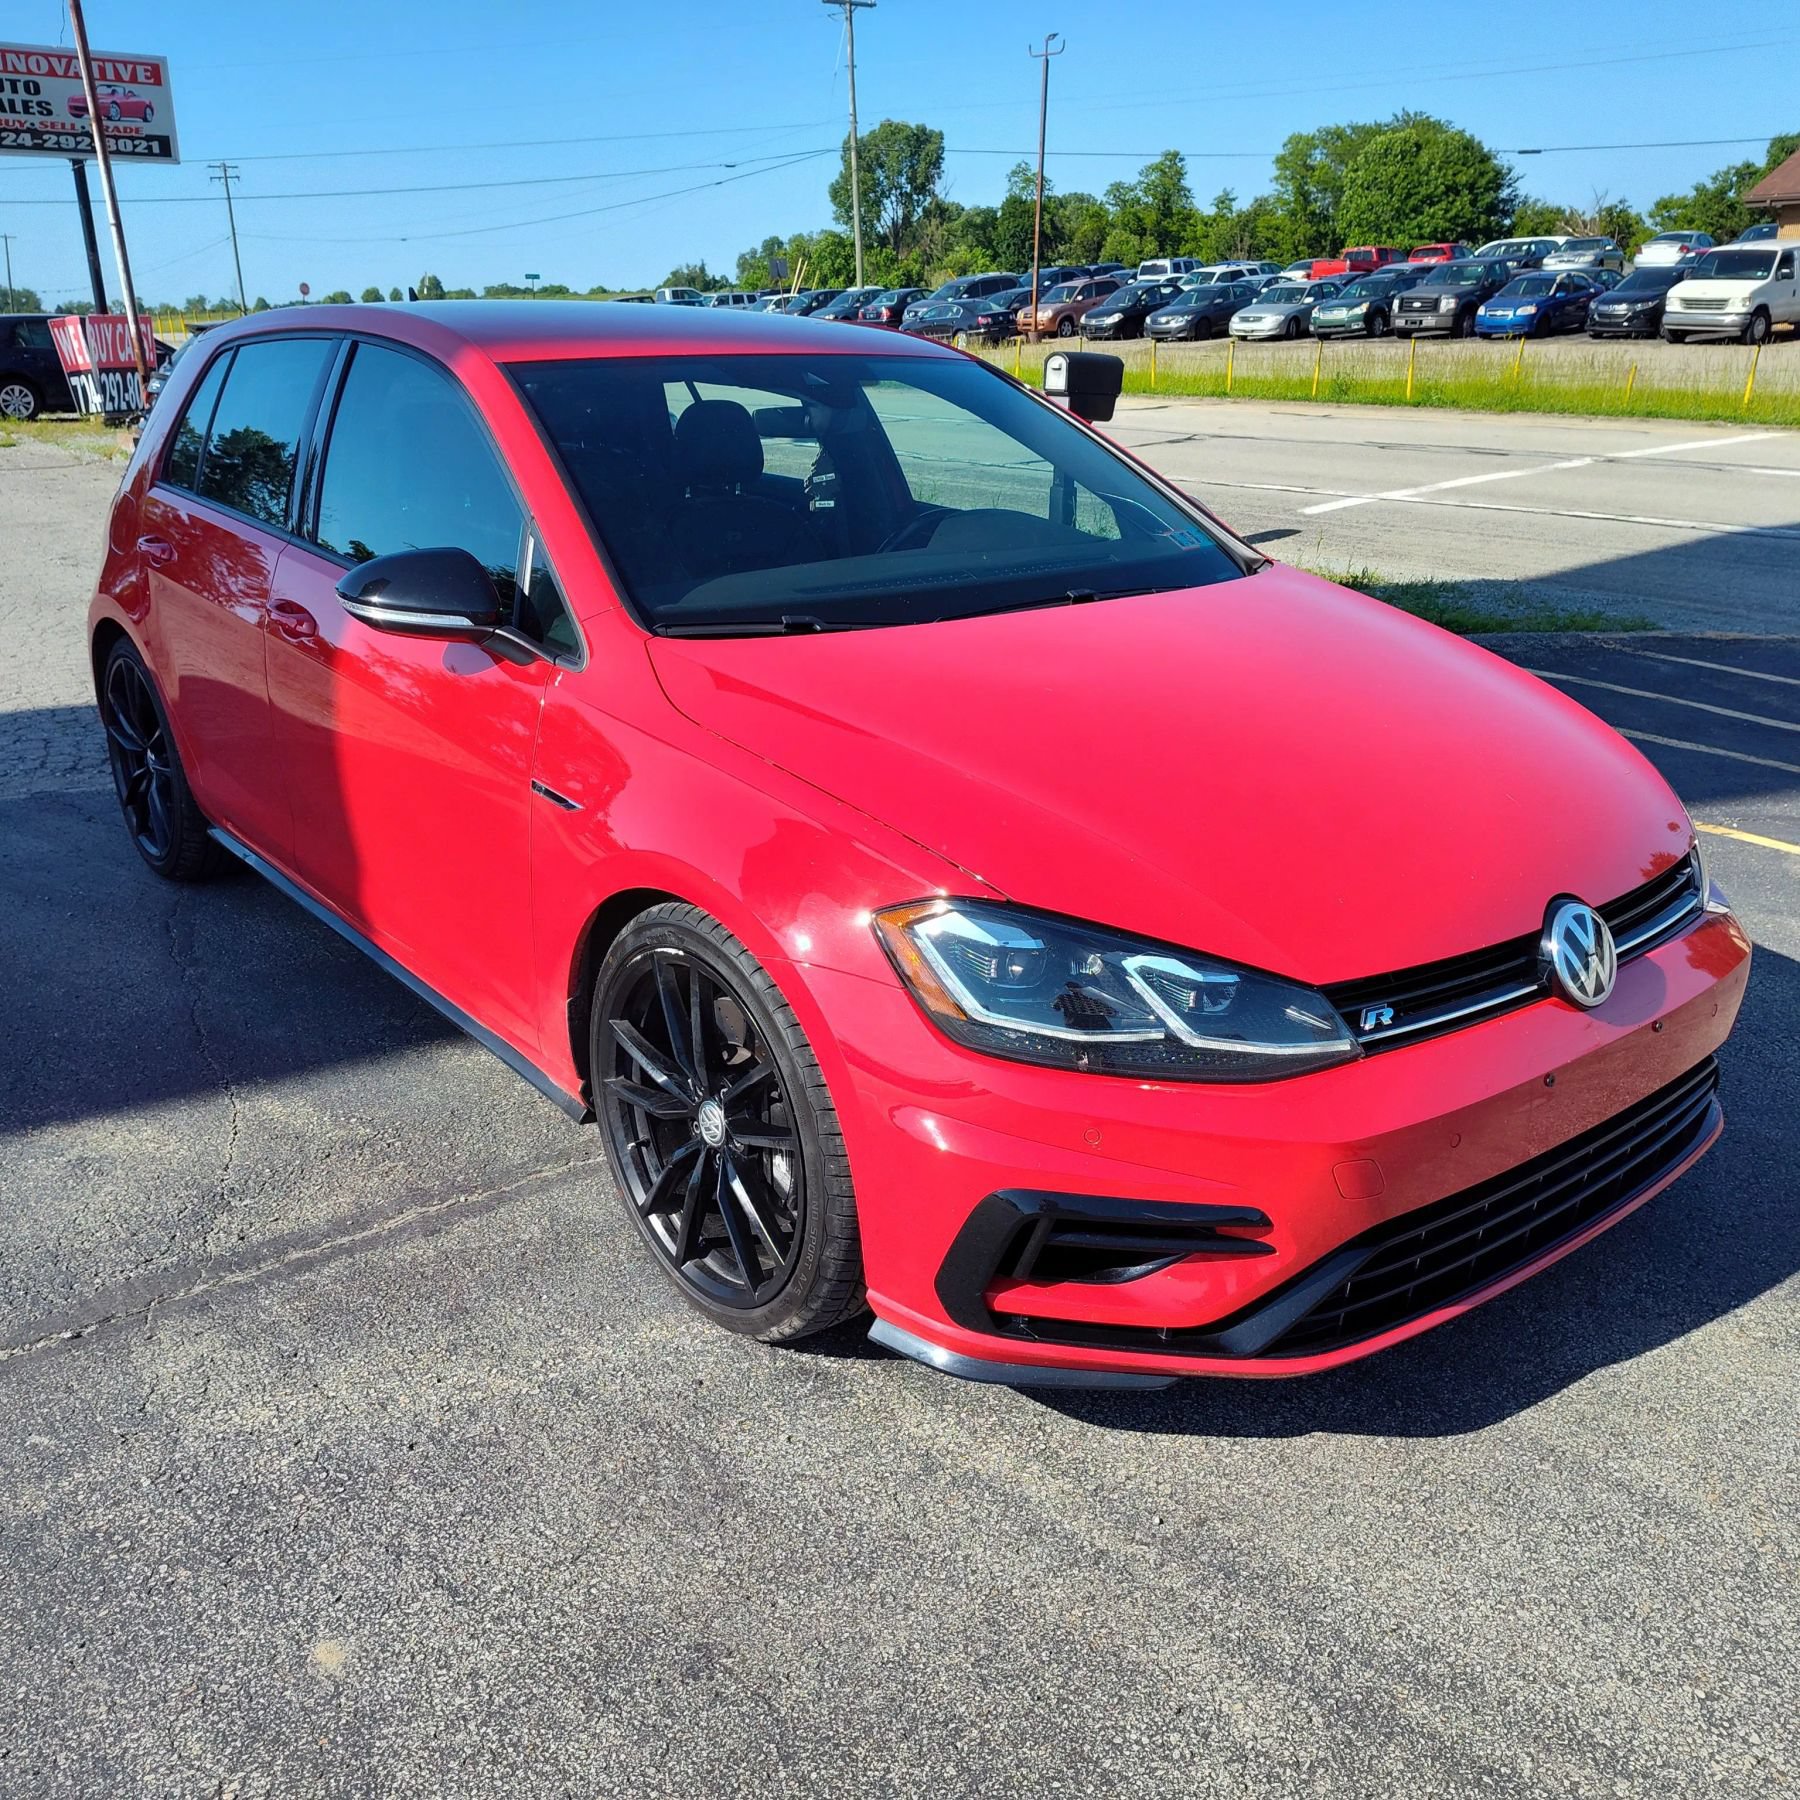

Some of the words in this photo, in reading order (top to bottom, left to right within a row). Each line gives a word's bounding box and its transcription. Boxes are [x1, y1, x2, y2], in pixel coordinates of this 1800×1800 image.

[0, 51, 155, 84] NOVATIVE
[38, 120, 81, 131] SELL
[92, 125, 145, 136] RADE
[54, 325, 84, 367] WE
[116, 323, 155, 363] CAS!
[1360, 1003, 1393, 1031] R
[804, 1226, 819, 1271] SPORT
